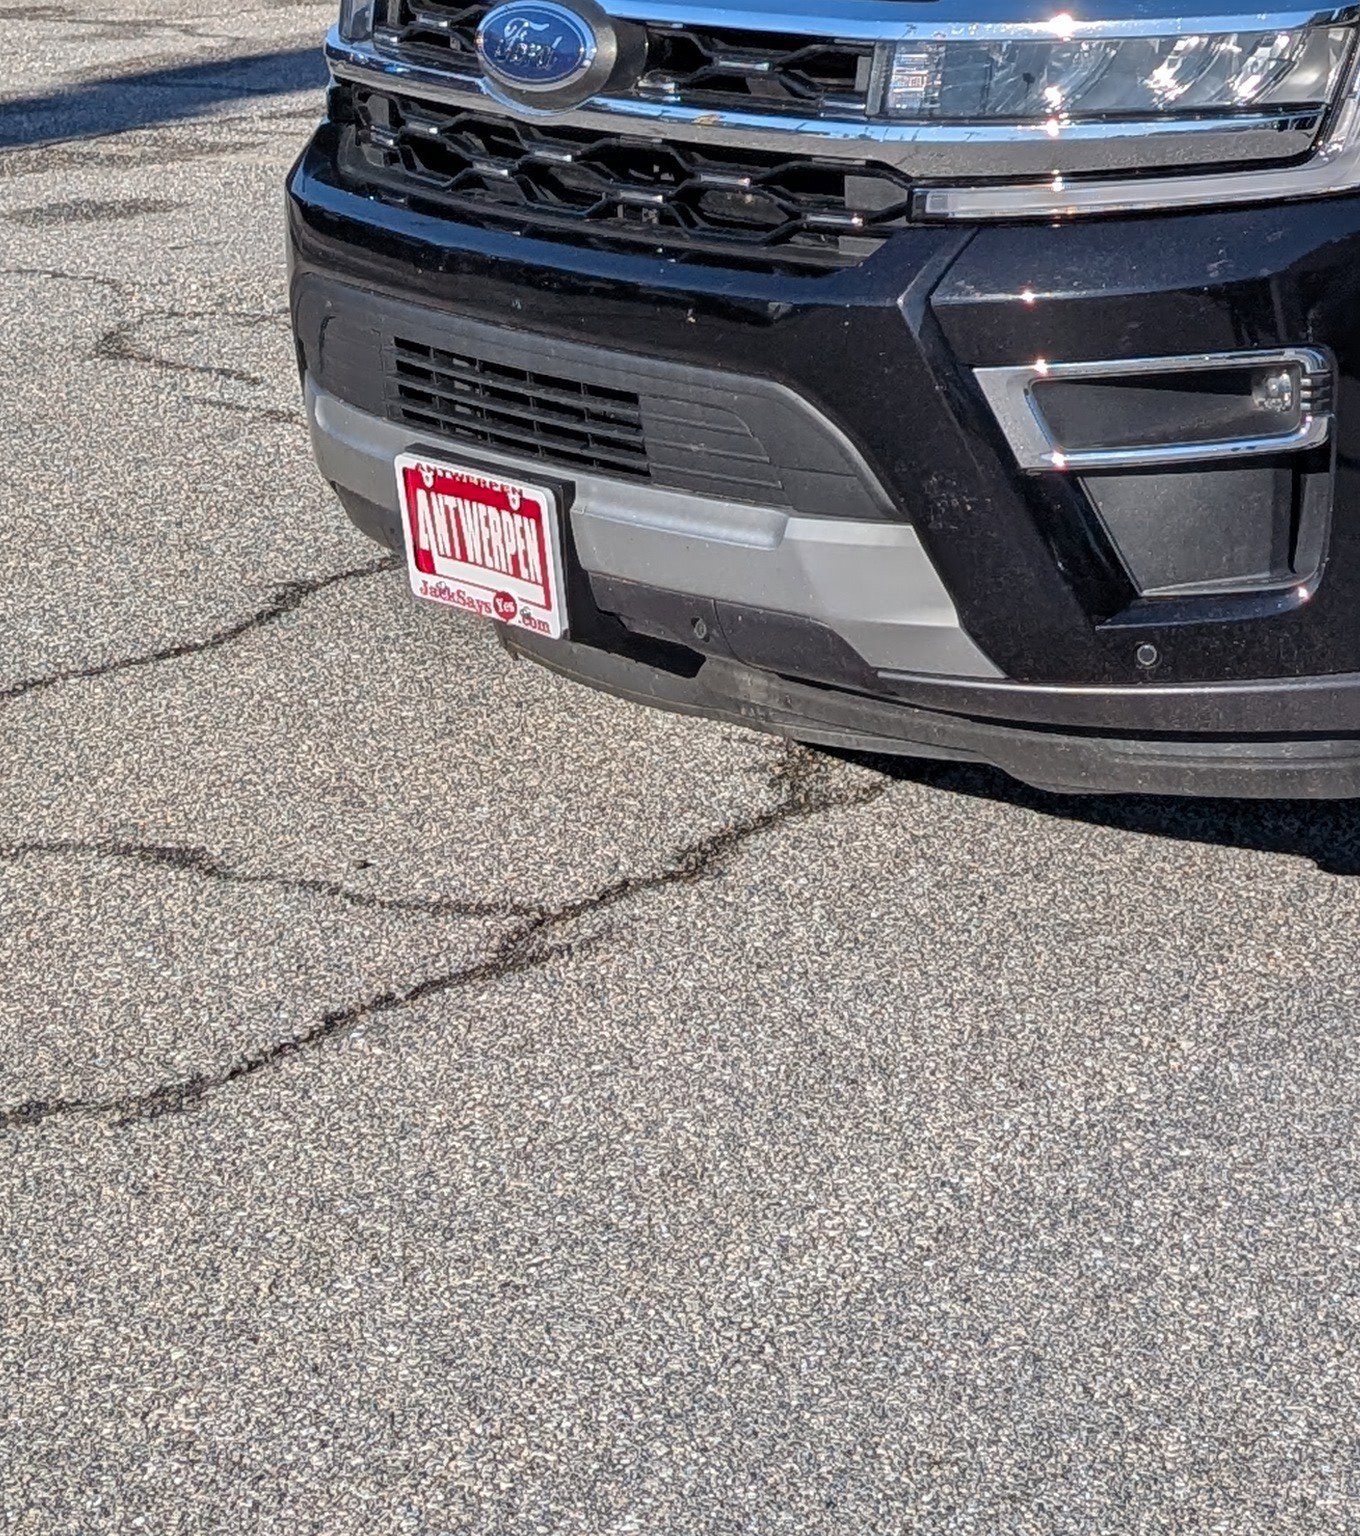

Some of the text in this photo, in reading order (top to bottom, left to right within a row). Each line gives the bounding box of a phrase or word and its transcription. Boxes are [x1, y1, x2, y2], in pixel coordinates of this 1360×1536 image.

[494, 16, 563, 71] Ford
[415, 461, 524, 498] ANTWERPEN
[415, 488, 543, 586] ANTWERPEN
